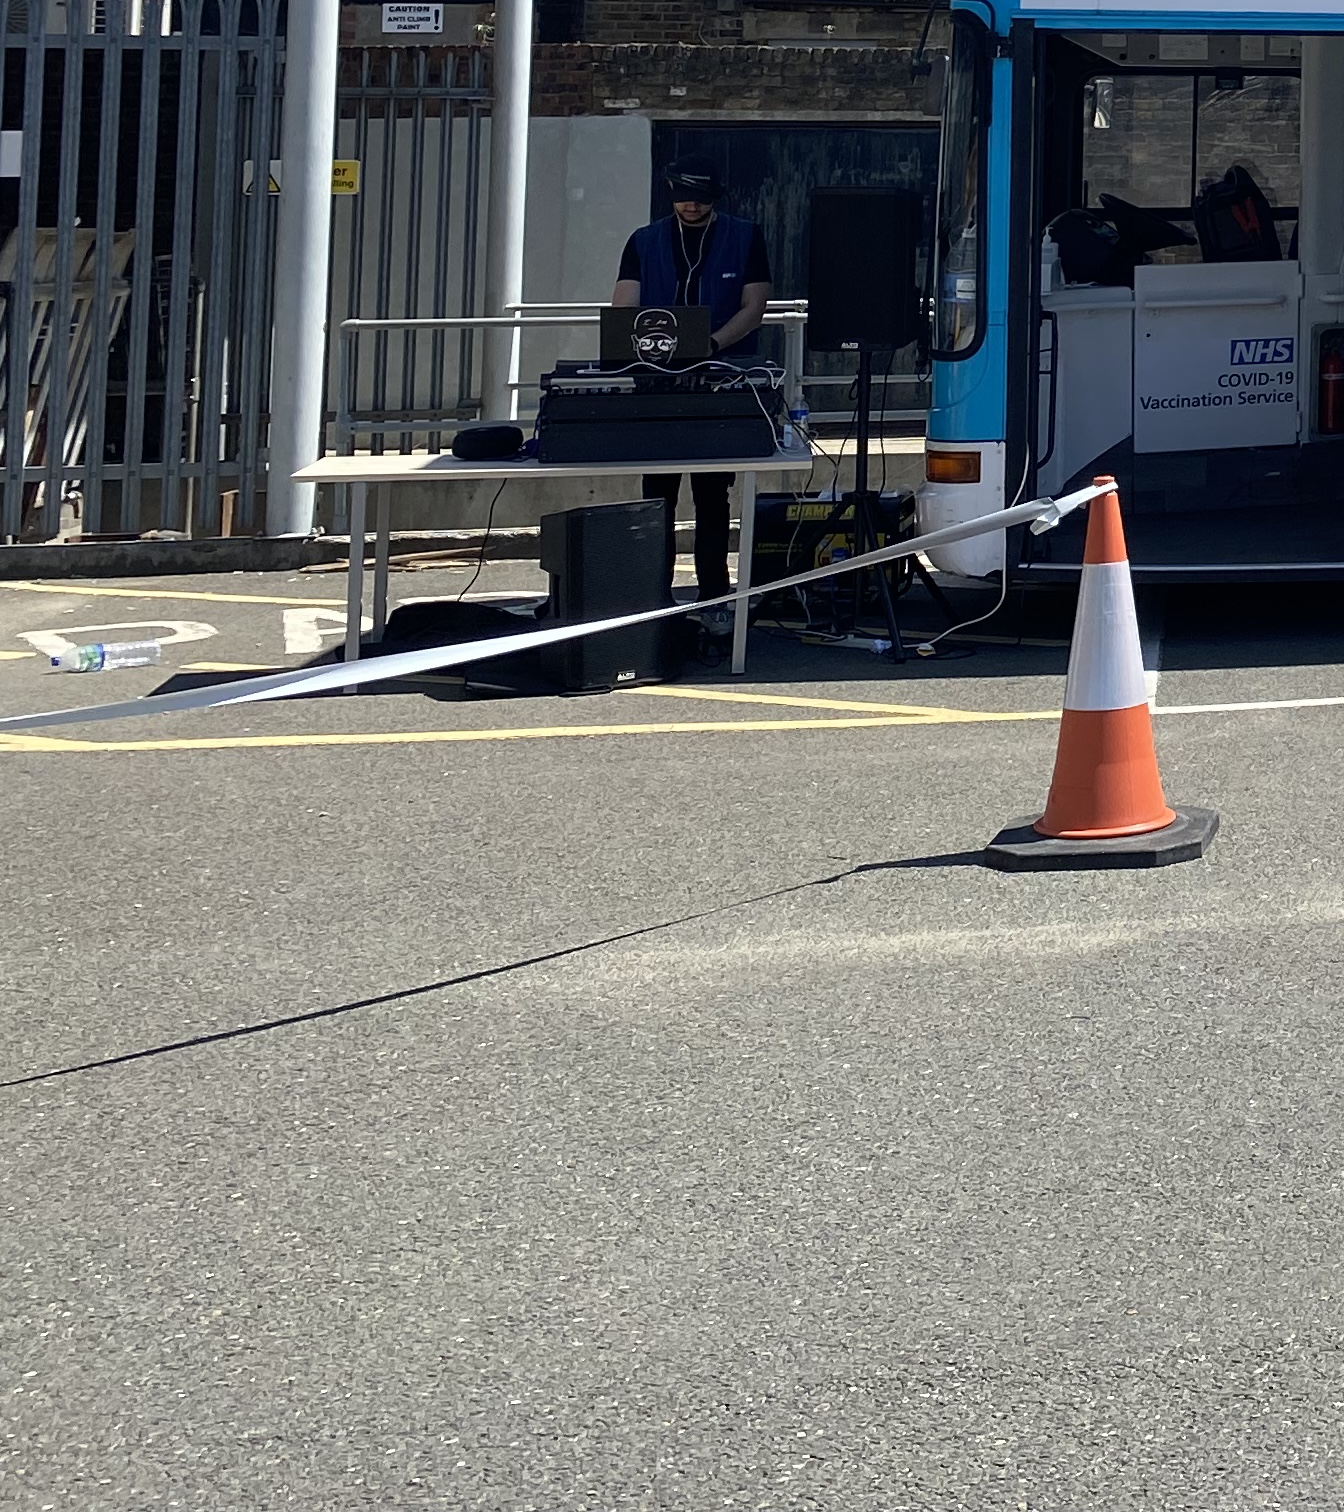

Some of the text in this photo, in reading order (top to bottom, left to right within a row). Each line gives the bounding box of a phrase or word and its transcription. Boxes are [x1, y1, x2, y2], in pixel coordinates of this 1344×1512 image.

[388, 5, 431, 13] CAUTION
[1231, 339, 1293, 364] NHS
[1217, 371, 1295, 388] COVID-19
[1139, 389, 1294, 411] Vaccination Service
